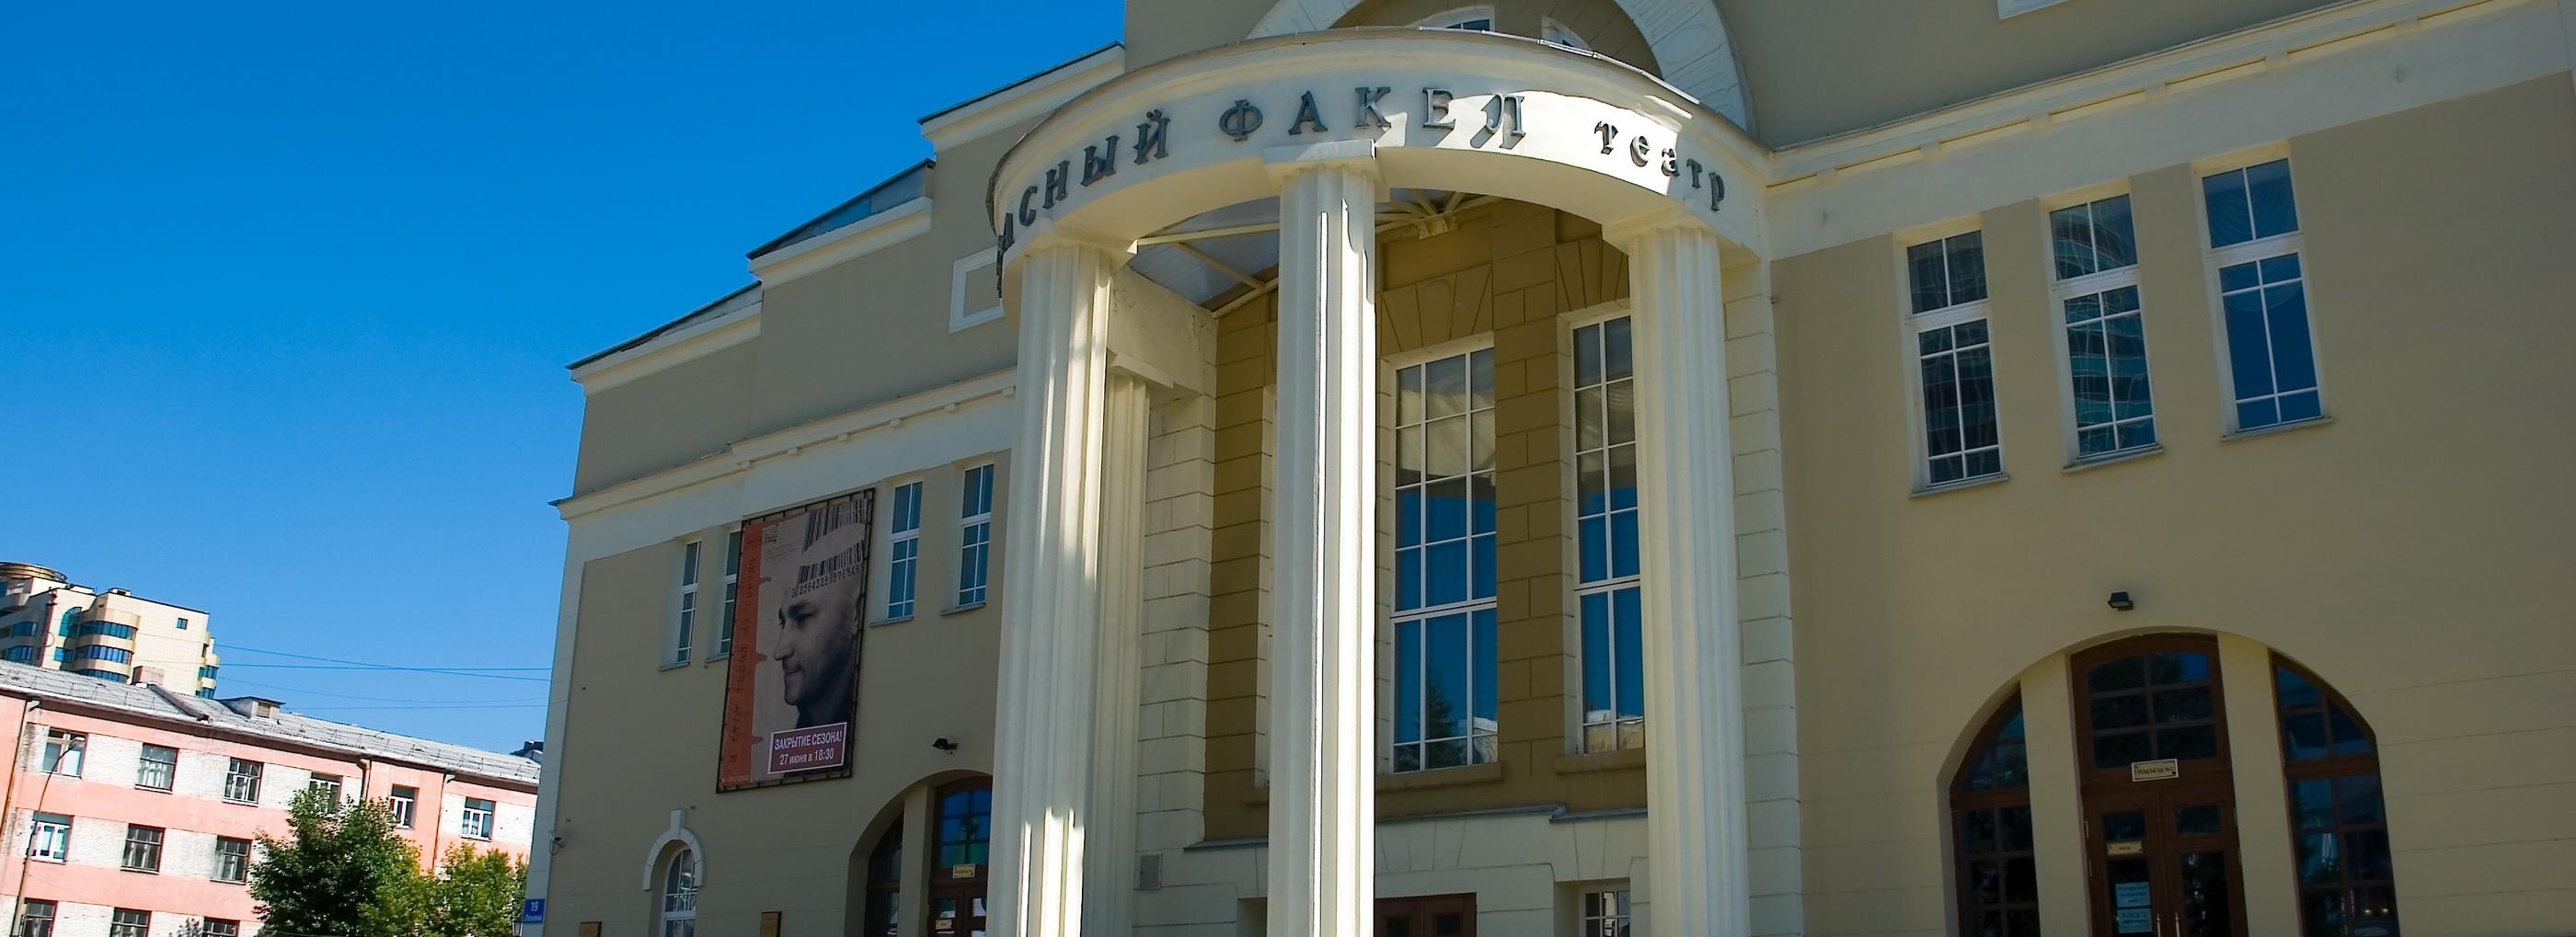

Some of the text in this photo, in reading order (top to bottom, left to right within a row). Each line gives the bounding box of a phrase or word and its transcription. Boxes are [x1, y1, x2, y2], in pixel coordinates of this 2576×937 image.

[996, 108, 1171, 297] АСНЫЙ
[1219, 86, 1526, 142] ФАКЕЛ
[775, 730, 843, 750] ЗАКРЫТИЕ СЕЗОНА!
[779, 753, 789, 766] 27
[814, 748, 835, 761] 18:30
[531, 901, 538, 912] 19
